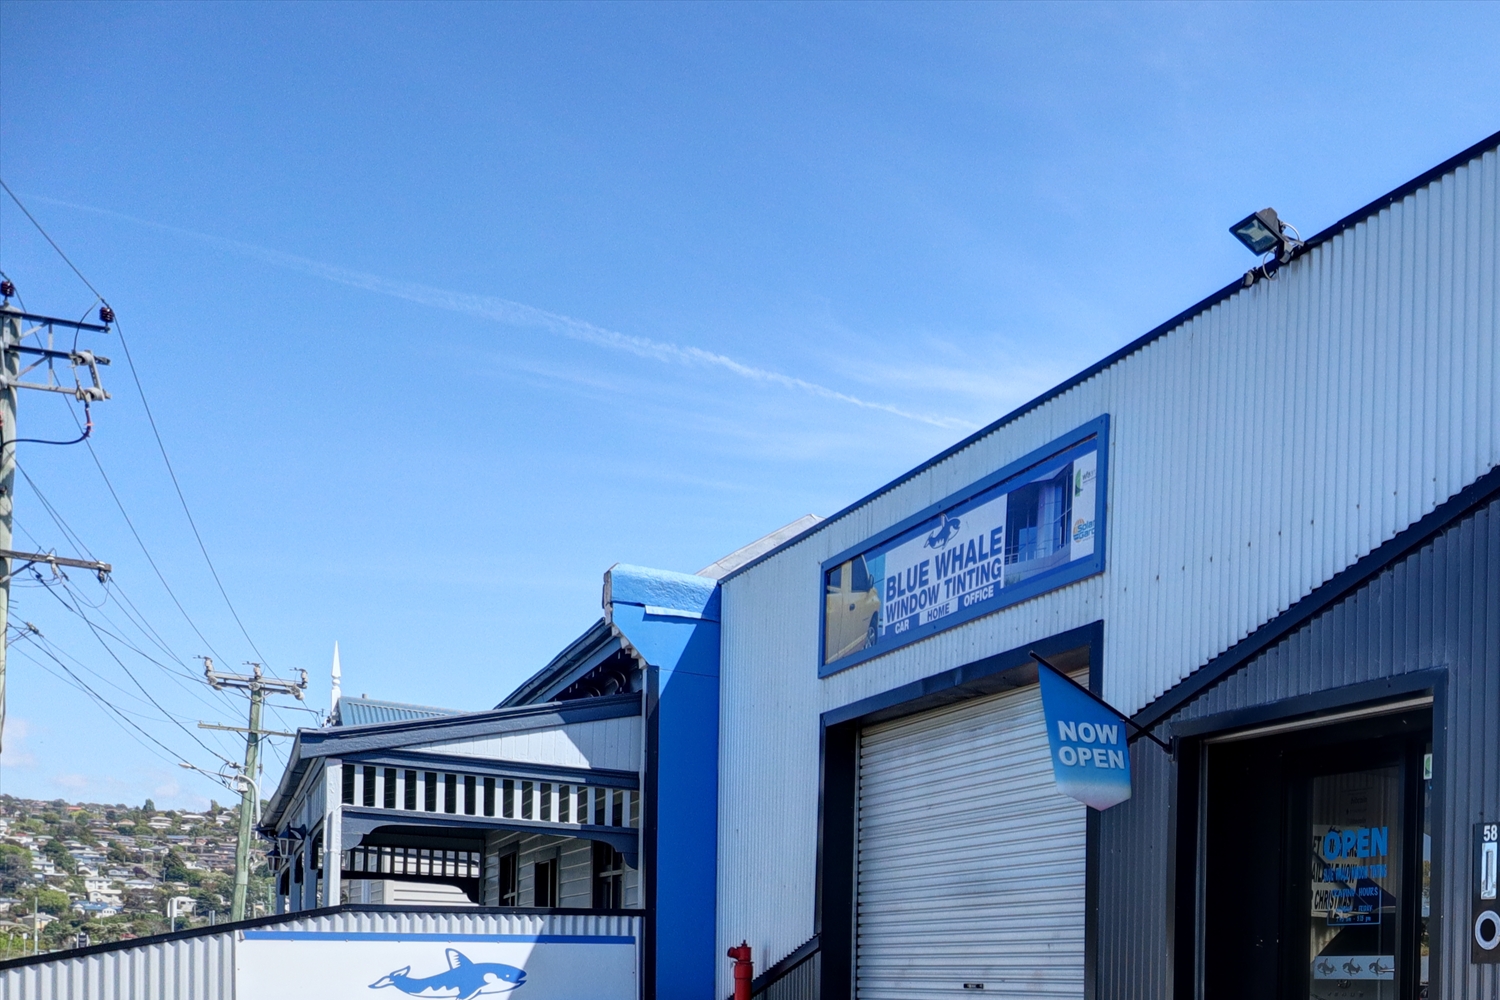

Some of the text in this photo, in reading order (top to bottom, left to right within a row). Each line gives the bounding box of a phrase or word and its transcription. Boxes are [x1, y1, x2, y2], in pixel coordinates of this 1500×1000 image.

[886, 526, 1003, 603] BLUE WHALE
[886, 558, 1002, 623] WINDOW TINTING
[895, 585, 994, 634] CAR HOME OFFICE
[1057, 720, 1118, 745] NOW
[1058, 746, 1125, 769] OPEN
[1323, 826, 1388, 860] OPEN
[1483, 825, 1498, 842] 58
[1358, 886, 1379, 896] HOURS
